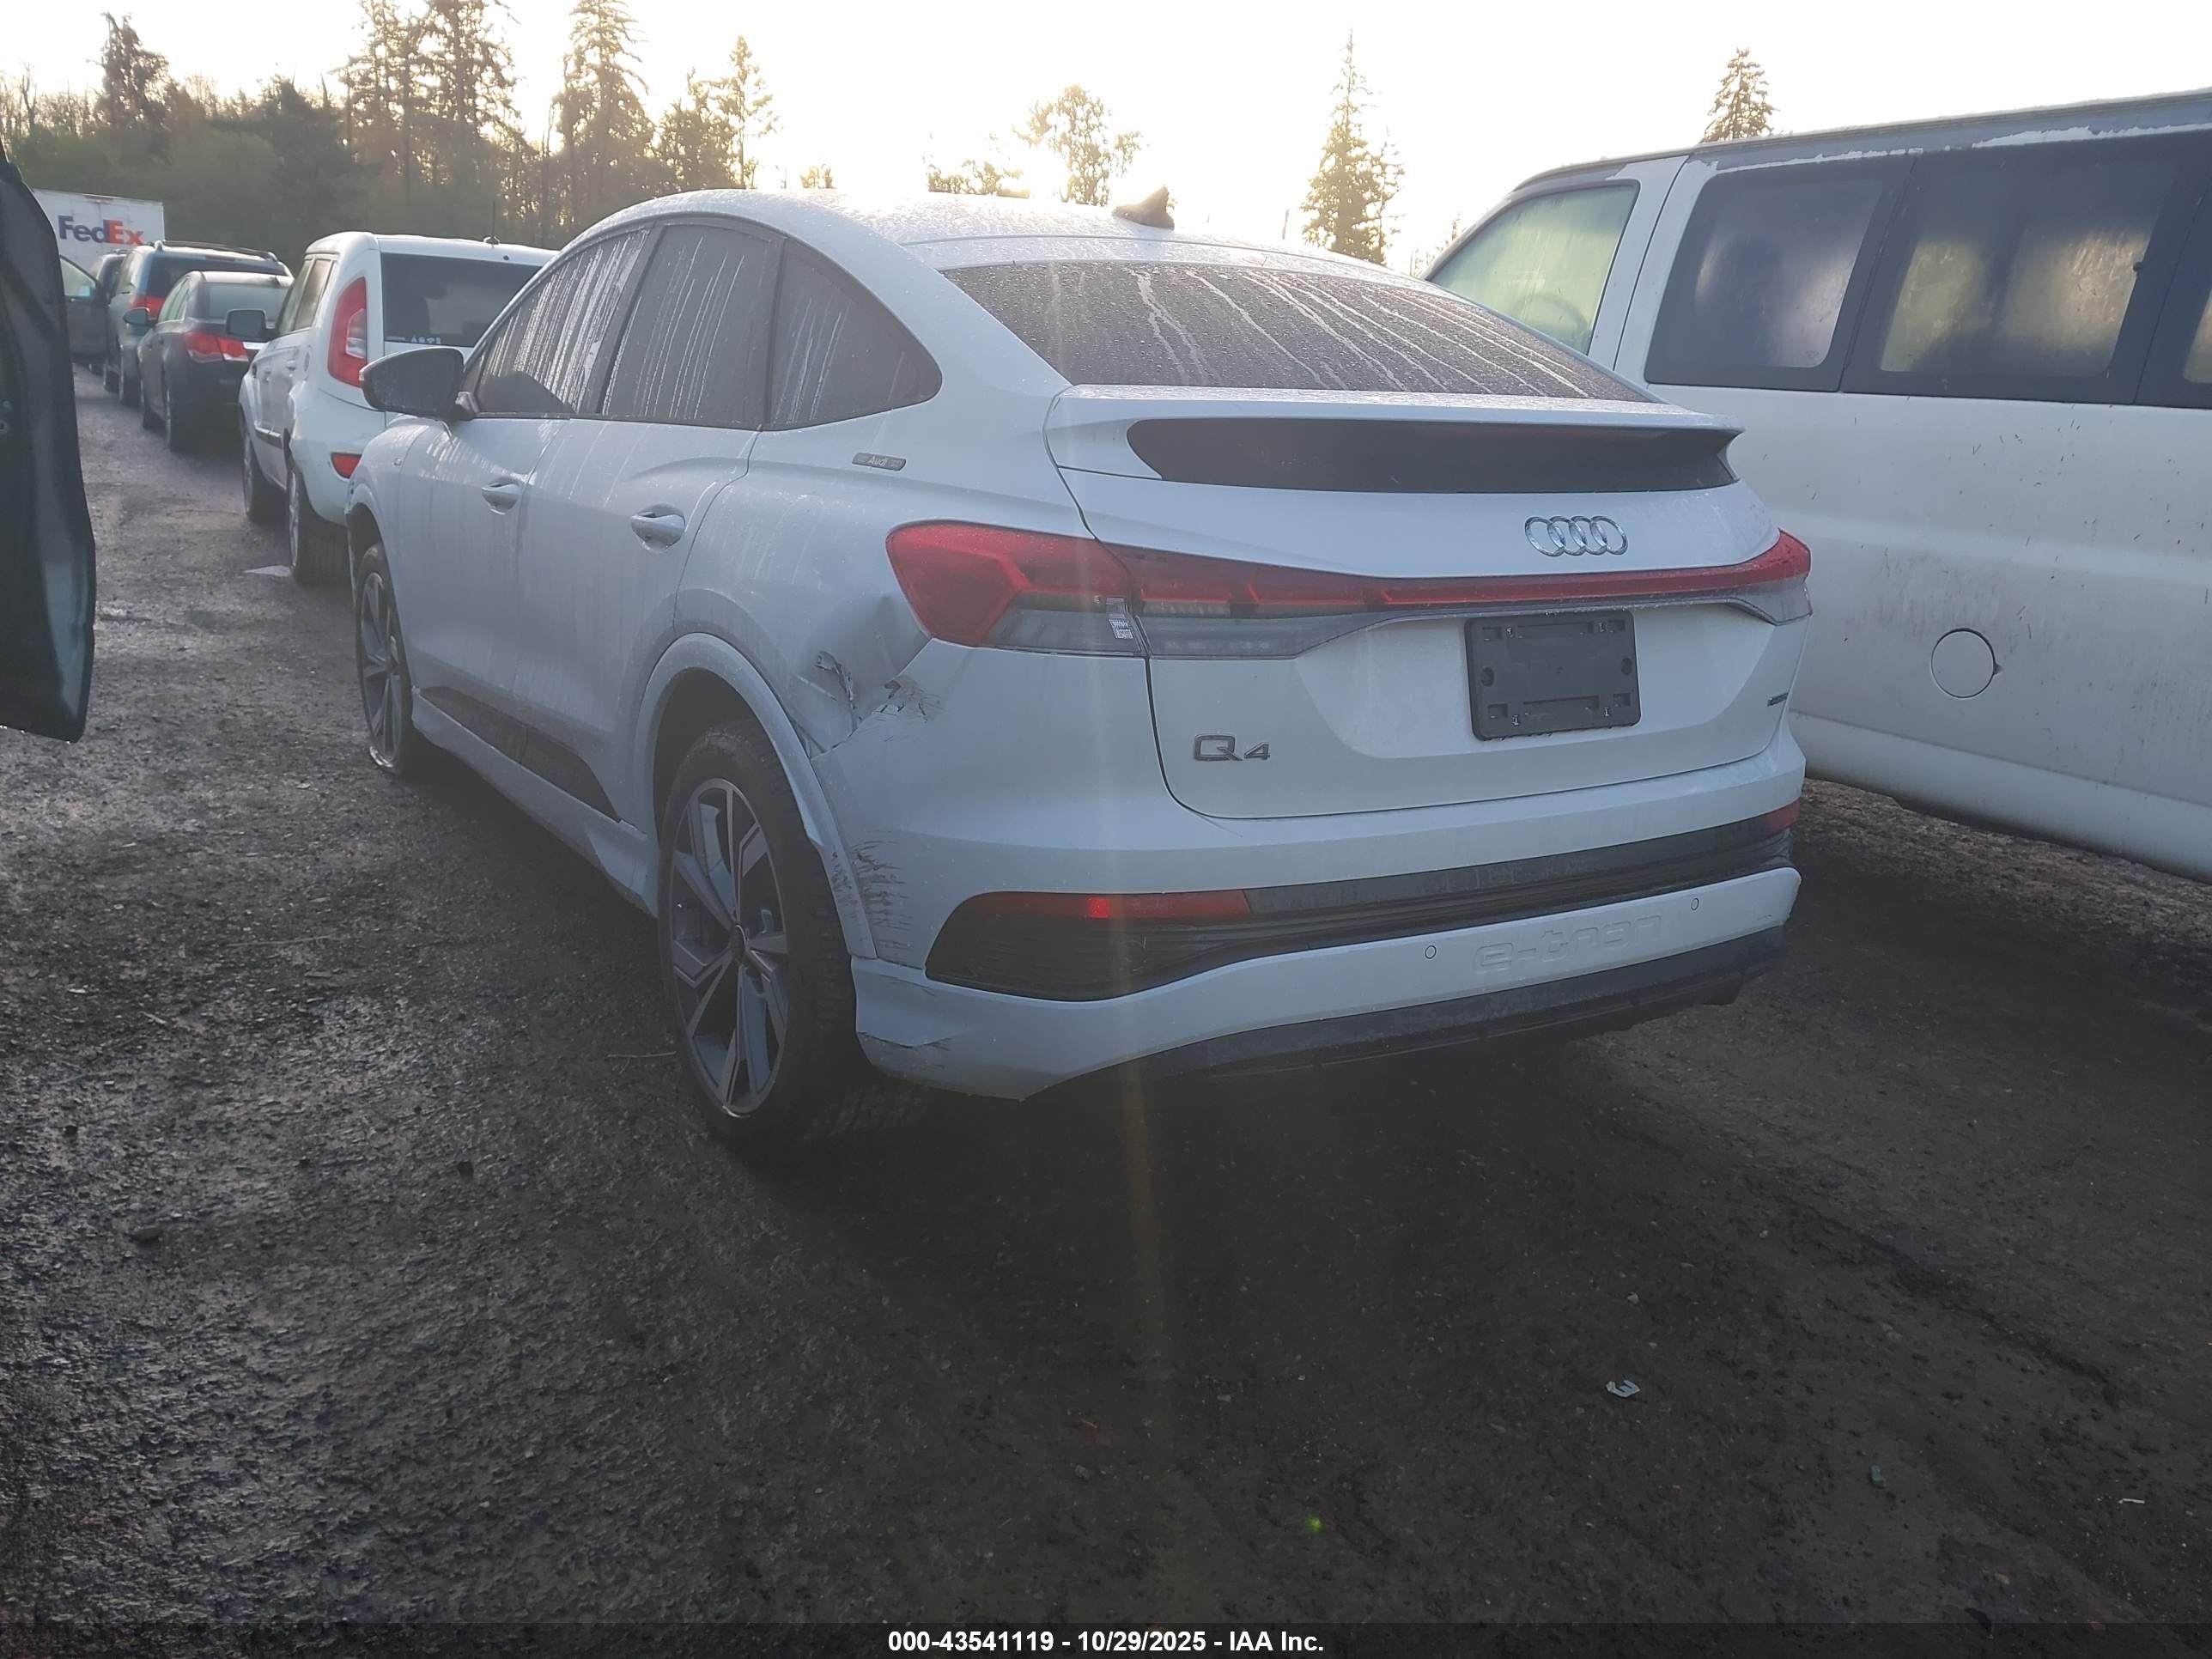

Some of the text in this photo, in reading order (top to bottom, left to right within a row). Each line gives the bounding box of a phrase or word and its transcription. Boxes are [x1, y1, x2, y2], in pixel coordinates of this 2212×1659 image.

[58, 215, 144, 246] FedEx
[867, 455, 888, 467] Audi
[1194, 734, 1271, 762] Q4
[1474, 915, 1662, 975] e-tron
